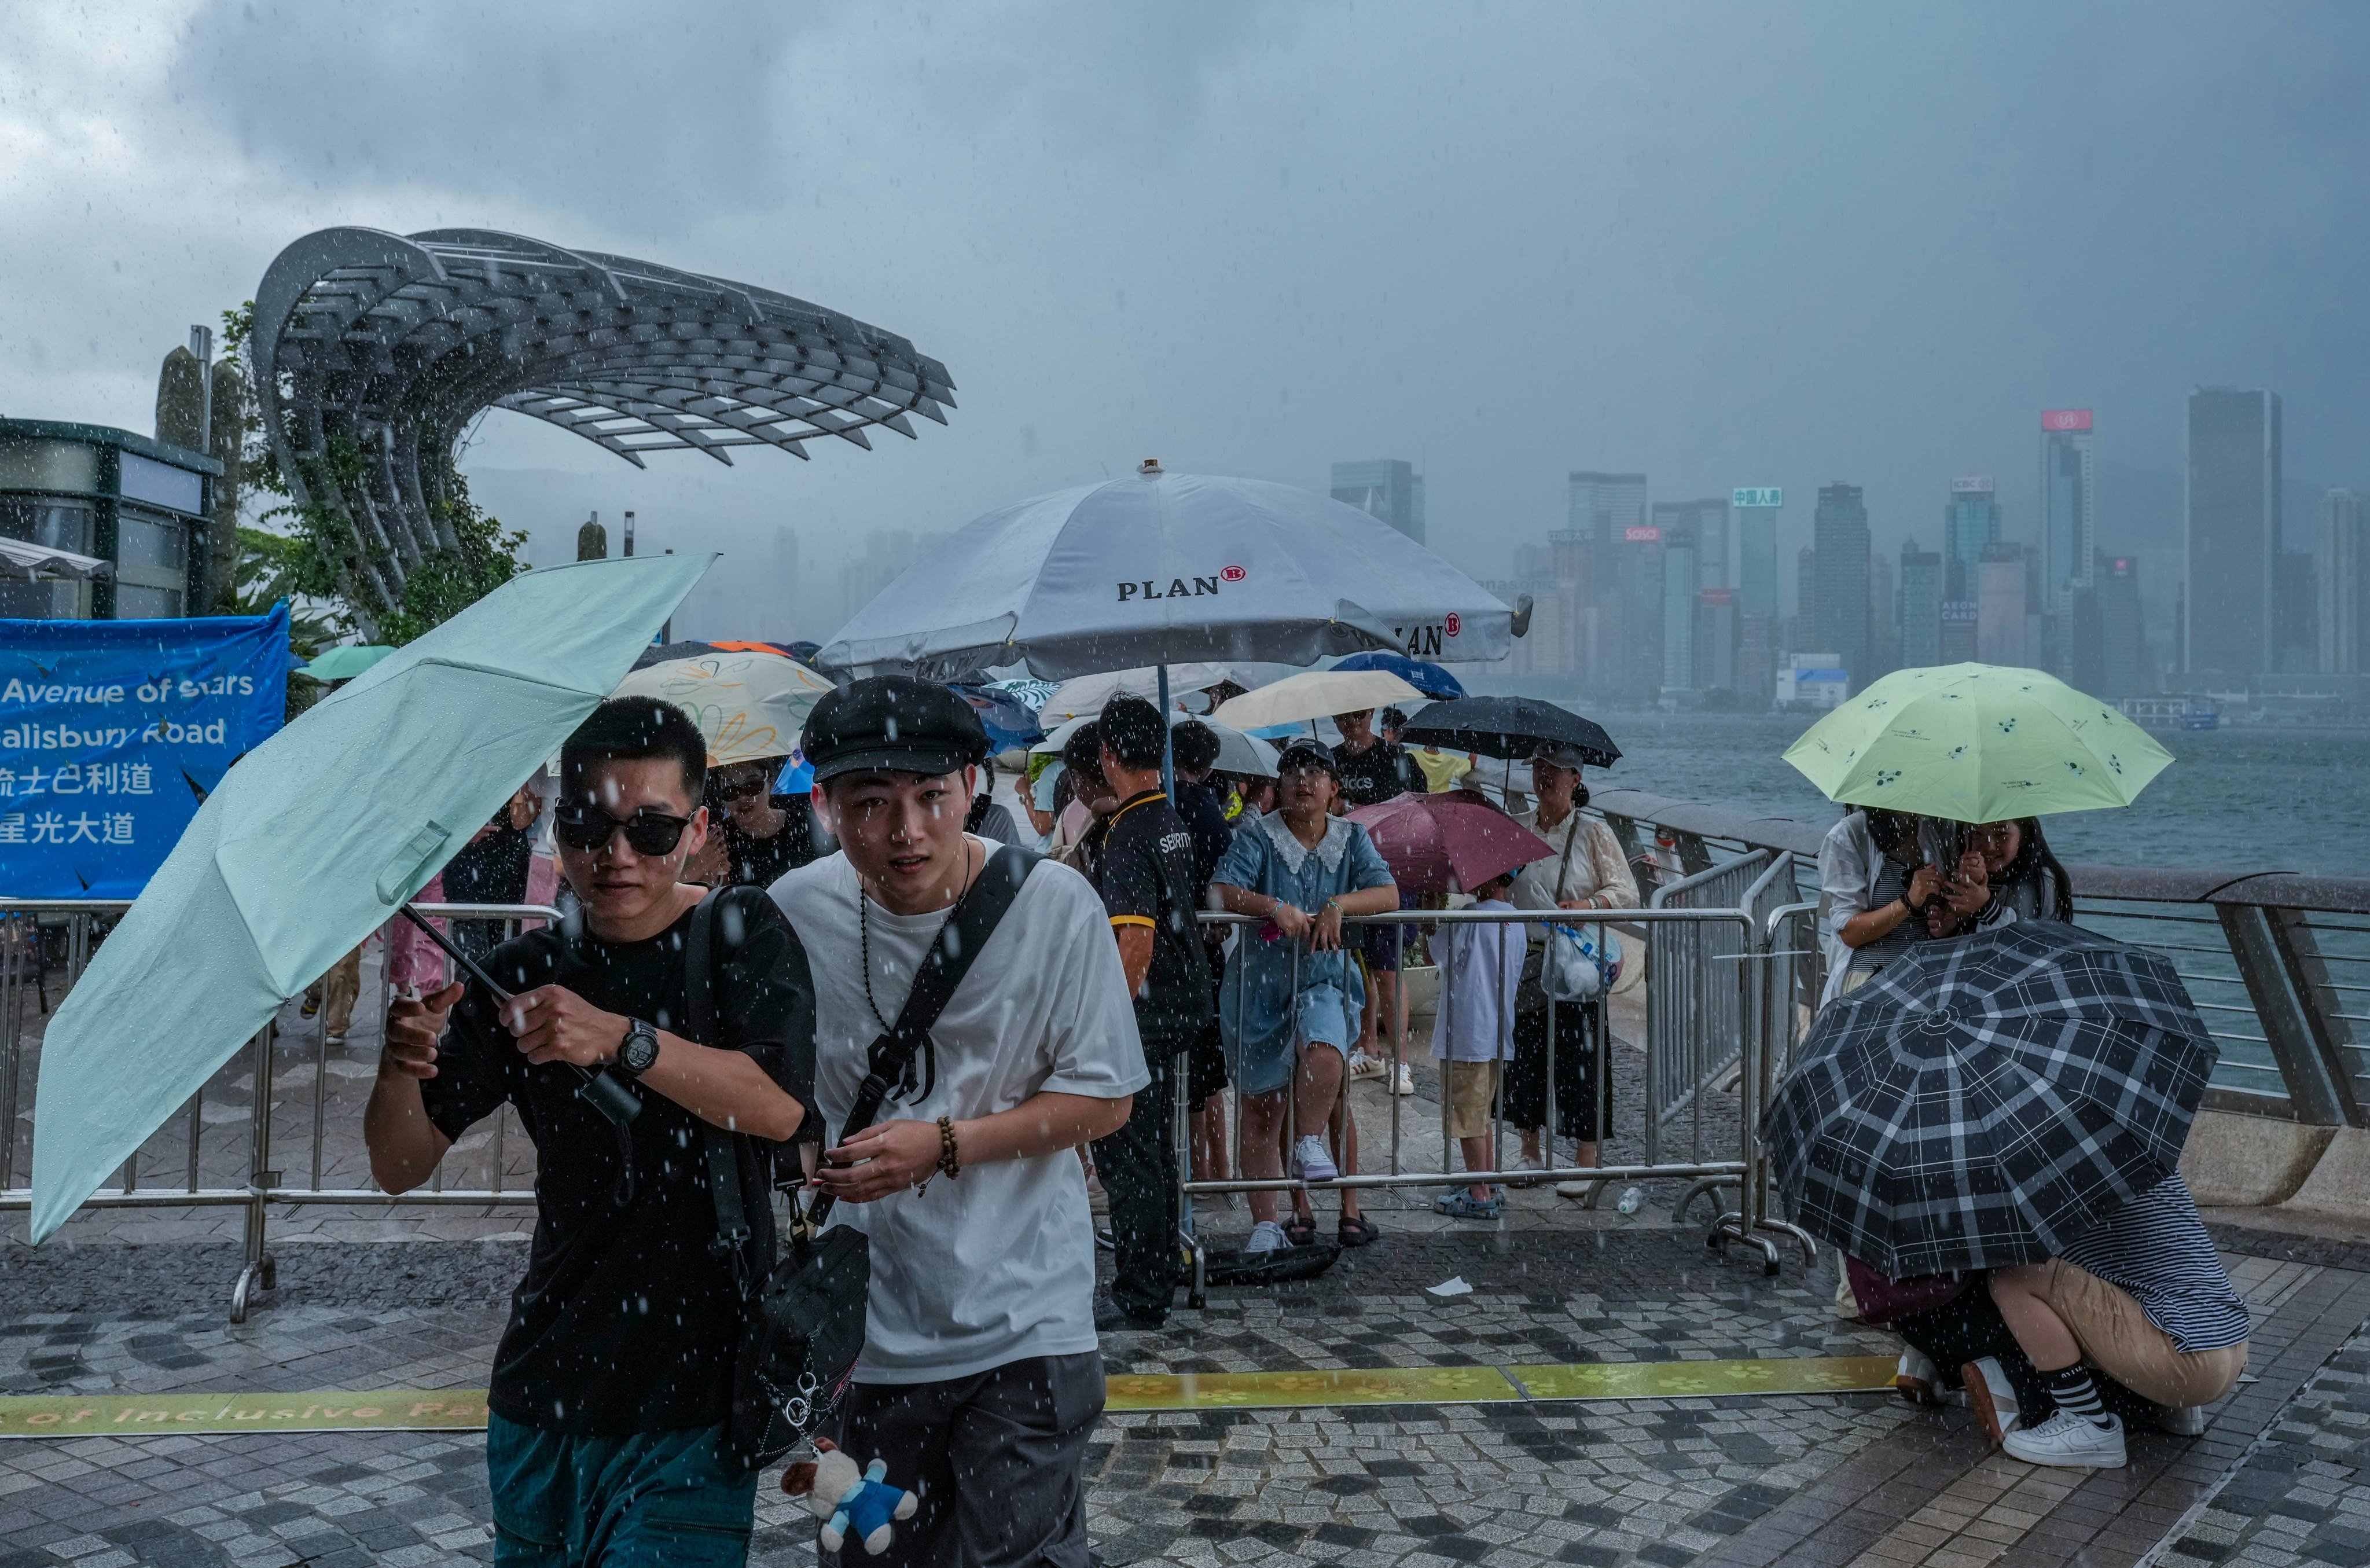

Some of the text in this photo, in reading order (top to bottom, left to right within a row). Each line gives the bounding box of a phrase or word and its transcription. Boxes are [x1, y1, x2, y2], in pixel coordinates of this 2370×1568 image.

[1953, 480, 1976, 489] ICBC
[1734, 489, 1781, 505] 中国人寿
[1116, 576, 1218, 601] PLAN
[1471, 577, 1557, 590] anasonic
[1942, 601, 1977, 610] AEON
[1942, 611, 1977, 620] CARD
[2, 678, 124, 703] Avenue
[137, 678, 172, 703] of
[0, 718, 225, 748] alisbury Road
[0, 811, 135, 844] 星光大道
[27, 1402, 489, 1424] of Inclusive Pa
